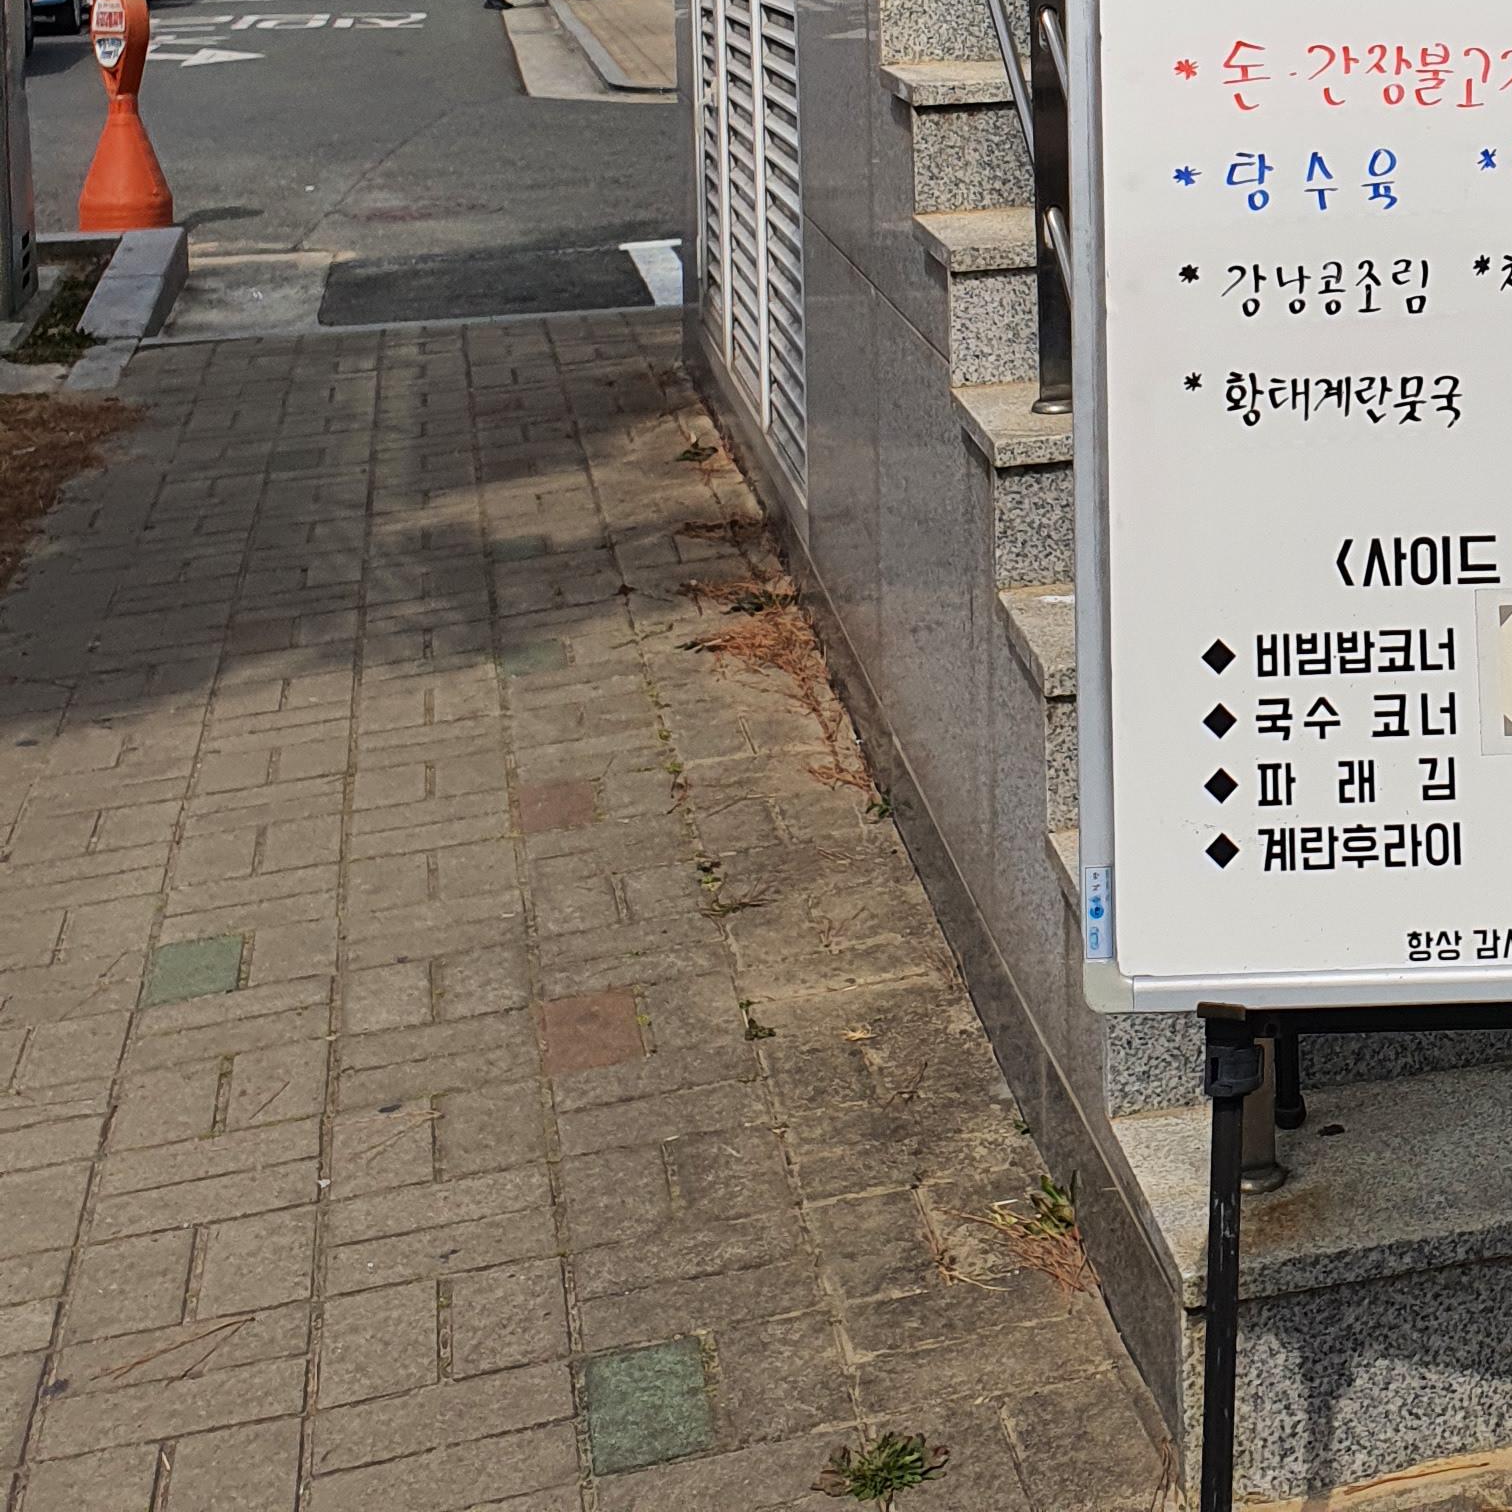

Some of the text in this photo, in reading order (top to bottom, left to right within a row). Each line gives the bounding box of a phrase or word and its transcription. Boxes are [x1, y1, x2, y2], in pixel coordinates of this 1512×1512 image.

[1255, 627, 1458, 680] 비빔밥코너
[1254, 692, 1458, 742] 국수 코너
[1258, 820, 1463, 873] 계란후라이
[1406, 929, 1462, 961] 항상
